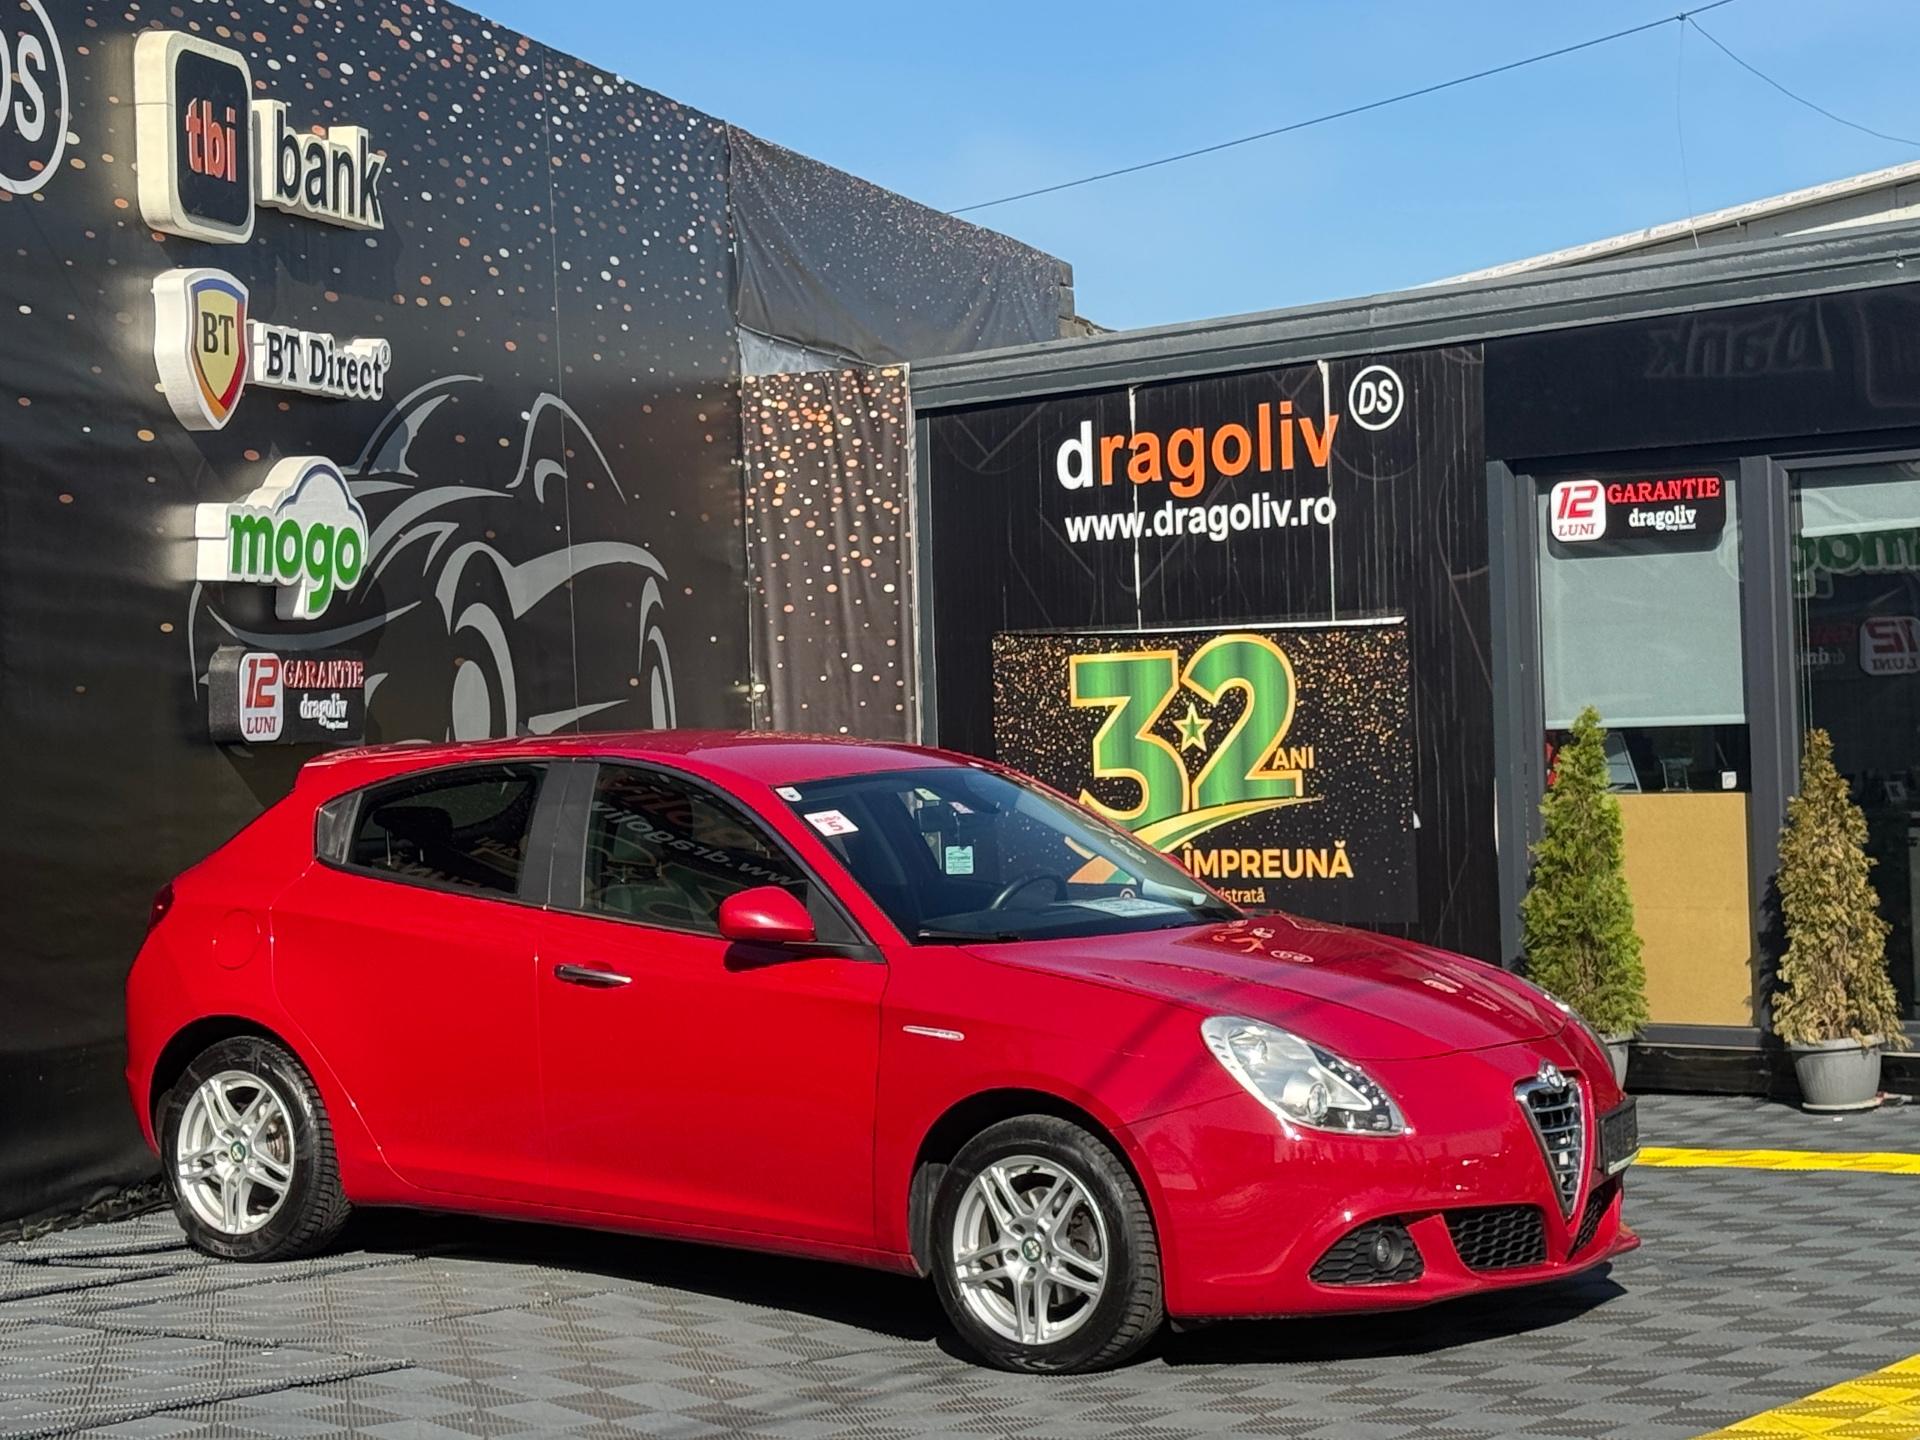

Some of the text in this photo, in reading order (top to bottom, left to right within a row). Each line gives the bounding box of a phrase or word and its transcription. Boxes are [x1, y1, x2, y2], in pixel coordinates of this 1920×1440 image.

[185, 97, 381, 223] tbi bank
[201, 311, 235, 356] BT
[266, 331, 301, 379] BT
[1358, 380, 1394, 416] DS
[1056, 400, 1340, 498] dragoliv
[1558, 485, 1599, 520] 12
[1606, 477, 1720, 505] GARANTIE
[1064, 492, 1337, 542] www.dragoliv.ro
[1558, 523, 1597, 536] LUNI
[1628, 504, 1697, 531] dragoliv
[229, 514, 362, 614] mogo
[245, 658, 281, 709] 12
[283, 659, 364, 689] GARANTIE
[246, 716, 277, 735] LUNI
[299, 692, 348, 727] dragoliv
[1069, 633, 1303, 832] 32
[1272, 746, 1315, 770] ANI
[1181, 839, 1355, 880] ÎMPREUNĂ
[1217, 886, 1266, 904] istrată
